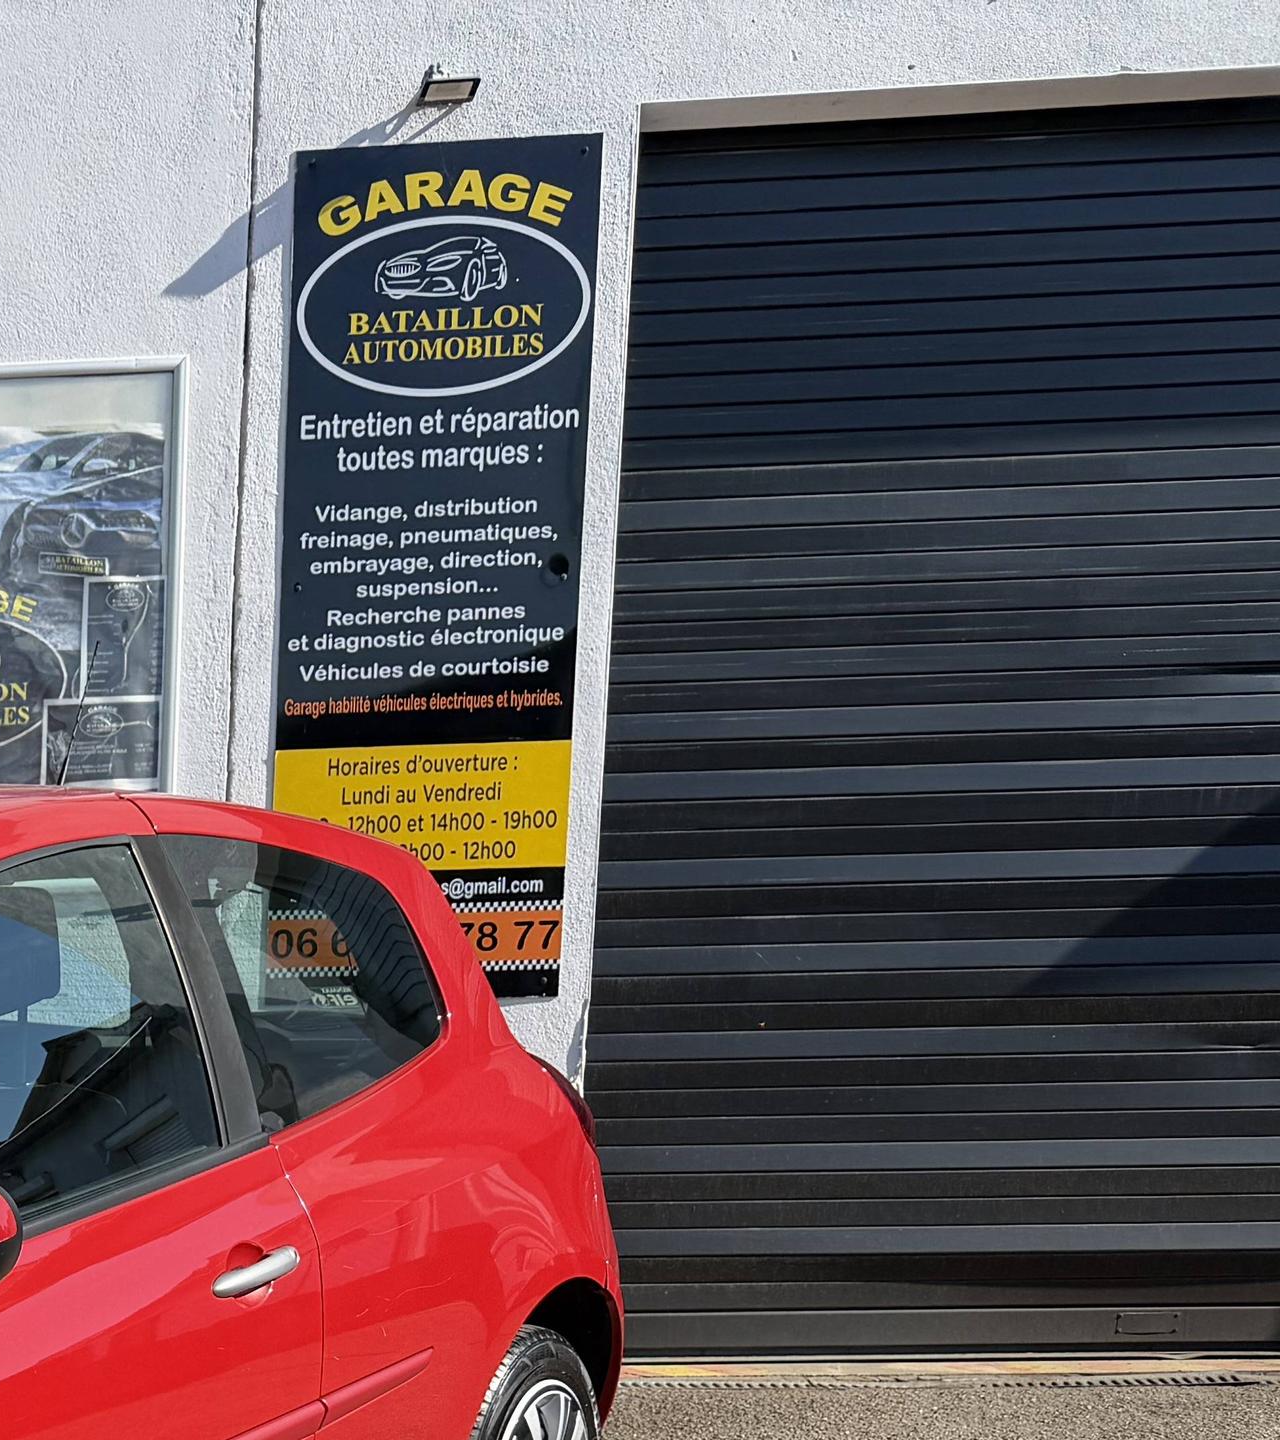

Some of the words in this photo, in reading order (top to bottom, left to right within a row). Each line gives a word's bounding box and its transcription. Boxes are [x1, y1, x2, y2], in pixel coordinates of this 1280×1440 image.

[317, 169, 573, 236] GARAGE
[348, 303, 544, 336] BATAILLON
[342, 333, 545, 365] AUTOMOBILES
[300, 411, 412, 440] Entretien
[420, 408, 444, 434] et
[450, 403, 580, 440] réparation
[337, 446, 414, 472] toutes
[421, 443, 529, 472] marques
[315, 504, 408, 523] Vidange,
[414, 497, 538, 519] distribution
[300, 532, 394, 551] freinage,
[400, 524, 558, 548] pneumatiques,
[310, 555, 434, 576] embrayage,
[440, 550, 543, 569] direction,
[356, 578, 499, 600] suspension...
[327, 607, 441, 627] Recherche
[447, 605, 526, 625] pannes
[288, 635, 309, 651] et
[314, 630, 425, 653] diagnostic
[430, 624, 565, 647] électronique
[299, 662, 403, 682] Véhicules
[409, 660, 436, 677] de
[443, 656, 550, 676] courtoisie
[284, 699, 326, 719] Garage
[329, 695, 371, 714] habilité
[373, 694, 427, 713] véhicules
[429, 691, 494, 712] électriques
[496, 692, 509, 707] et
[510, 689, 563, 709] hybrides.
[327, 757, 400, 777] Horaires
[341, 786, 390, 806] Lundi
[395, 788, 417, 803] au
[423, 781, 502, 802] Vendredi
[348, 814, 401, 834] 12h00
[407, 814, 424, 832] et
[430, 811, 485, 832] 14h00
[503, 810, 558, 830] 19h00
[462, 840, 516, 861] 12h00
[441, 876, 544, 899] s@gmail.com
[271, 927, 318, 959] 06
[514, 920, 560, 950] 77
